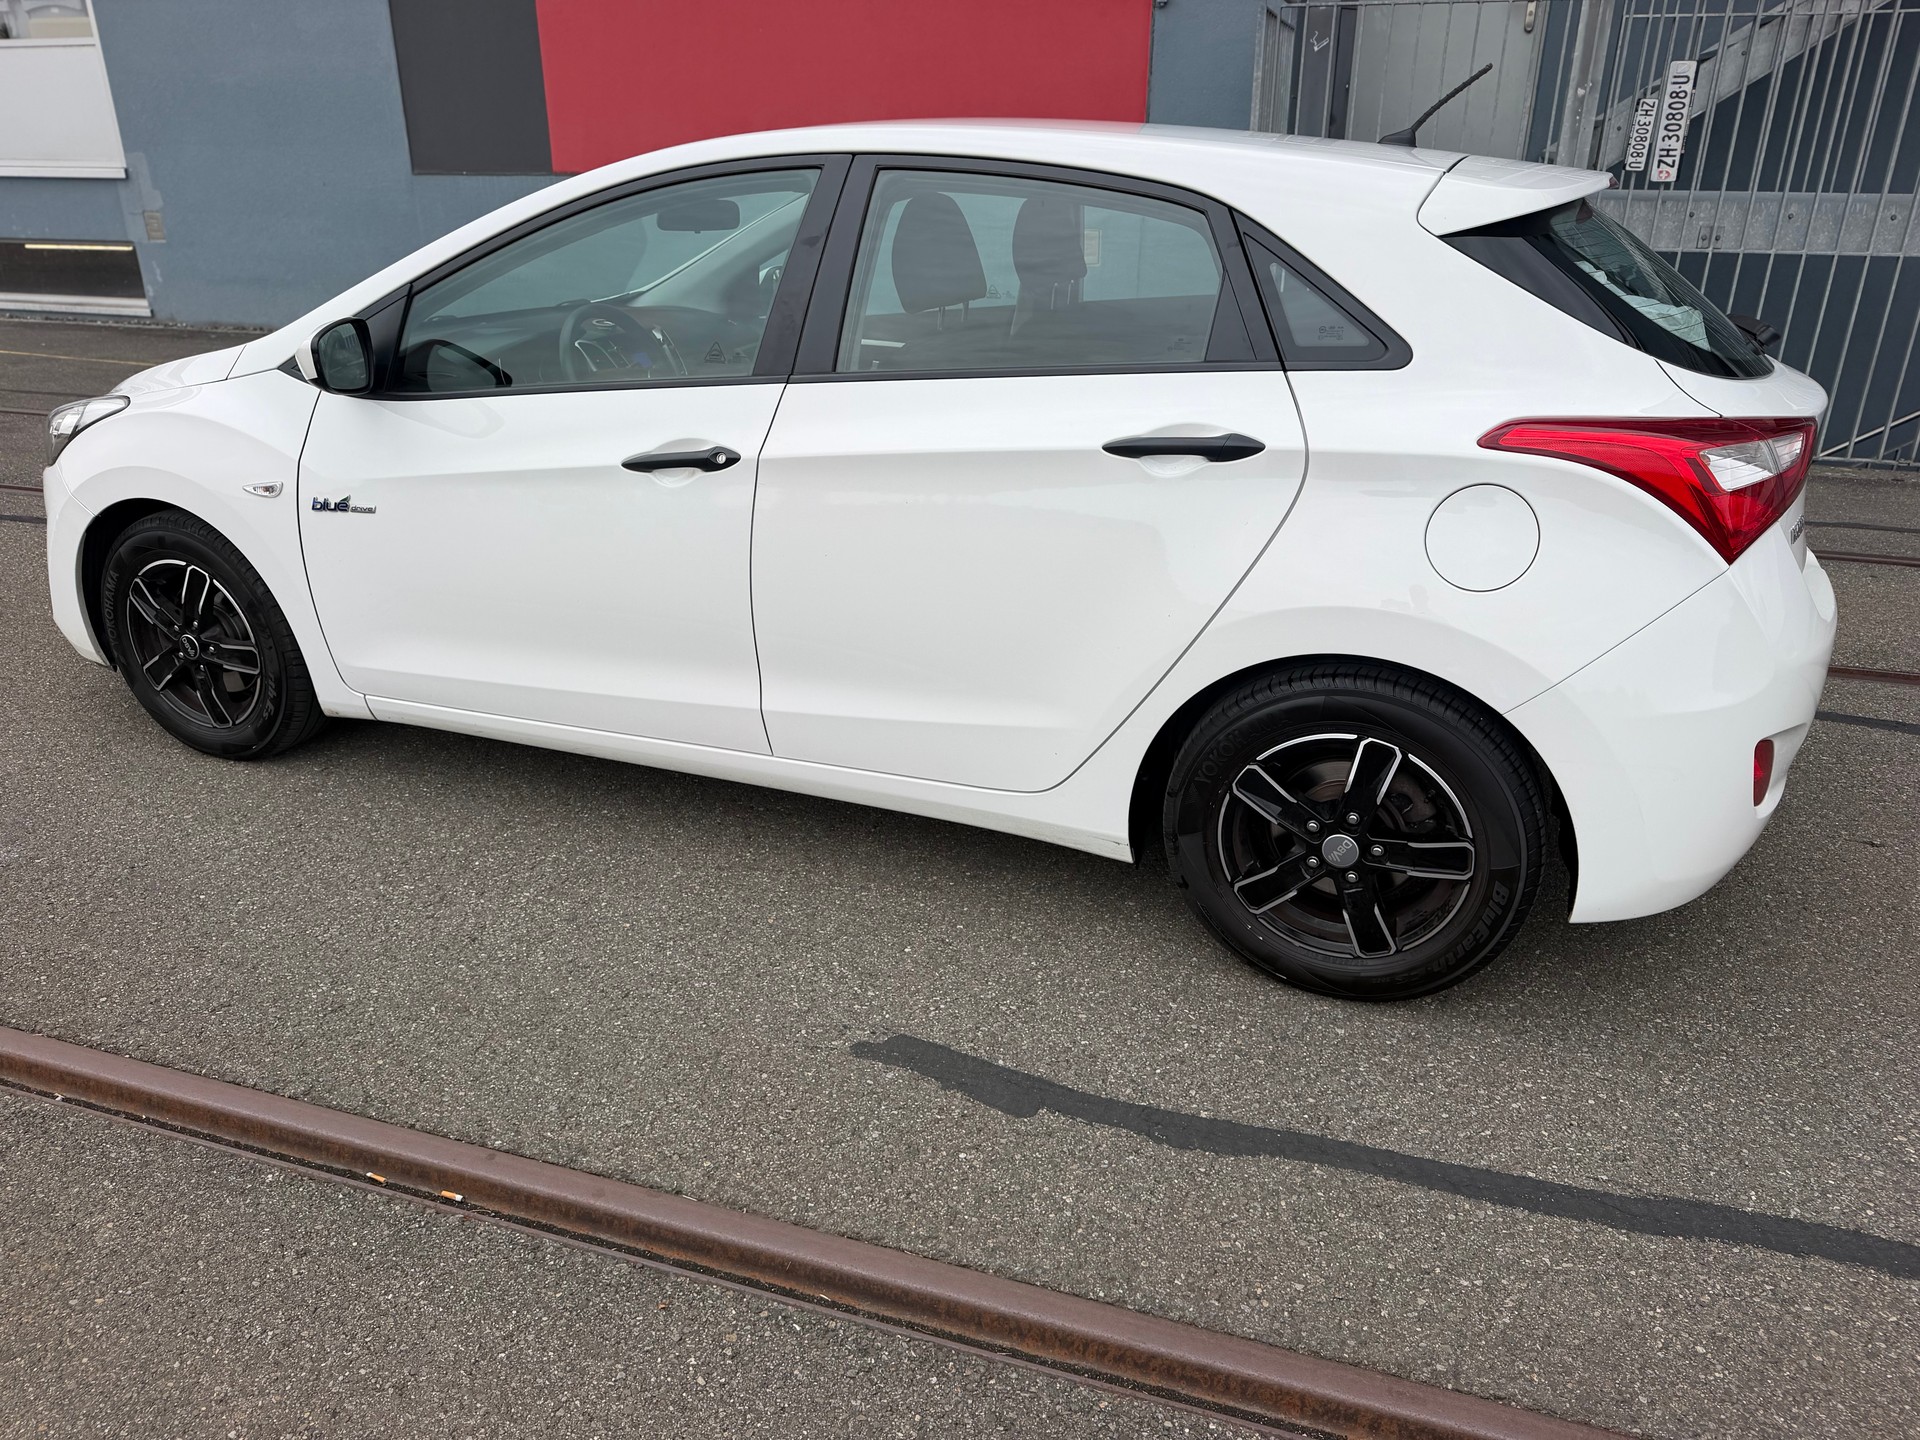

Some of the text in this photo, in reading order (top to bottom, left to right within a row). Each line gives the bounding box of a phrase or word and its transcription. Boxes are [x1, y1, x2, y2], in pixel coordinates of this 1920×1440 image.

[311, 496, 350, 512] blue
[104, 569, 120, 646] YOKOHAMA
[1329, 840, 1353, 862] DBV
